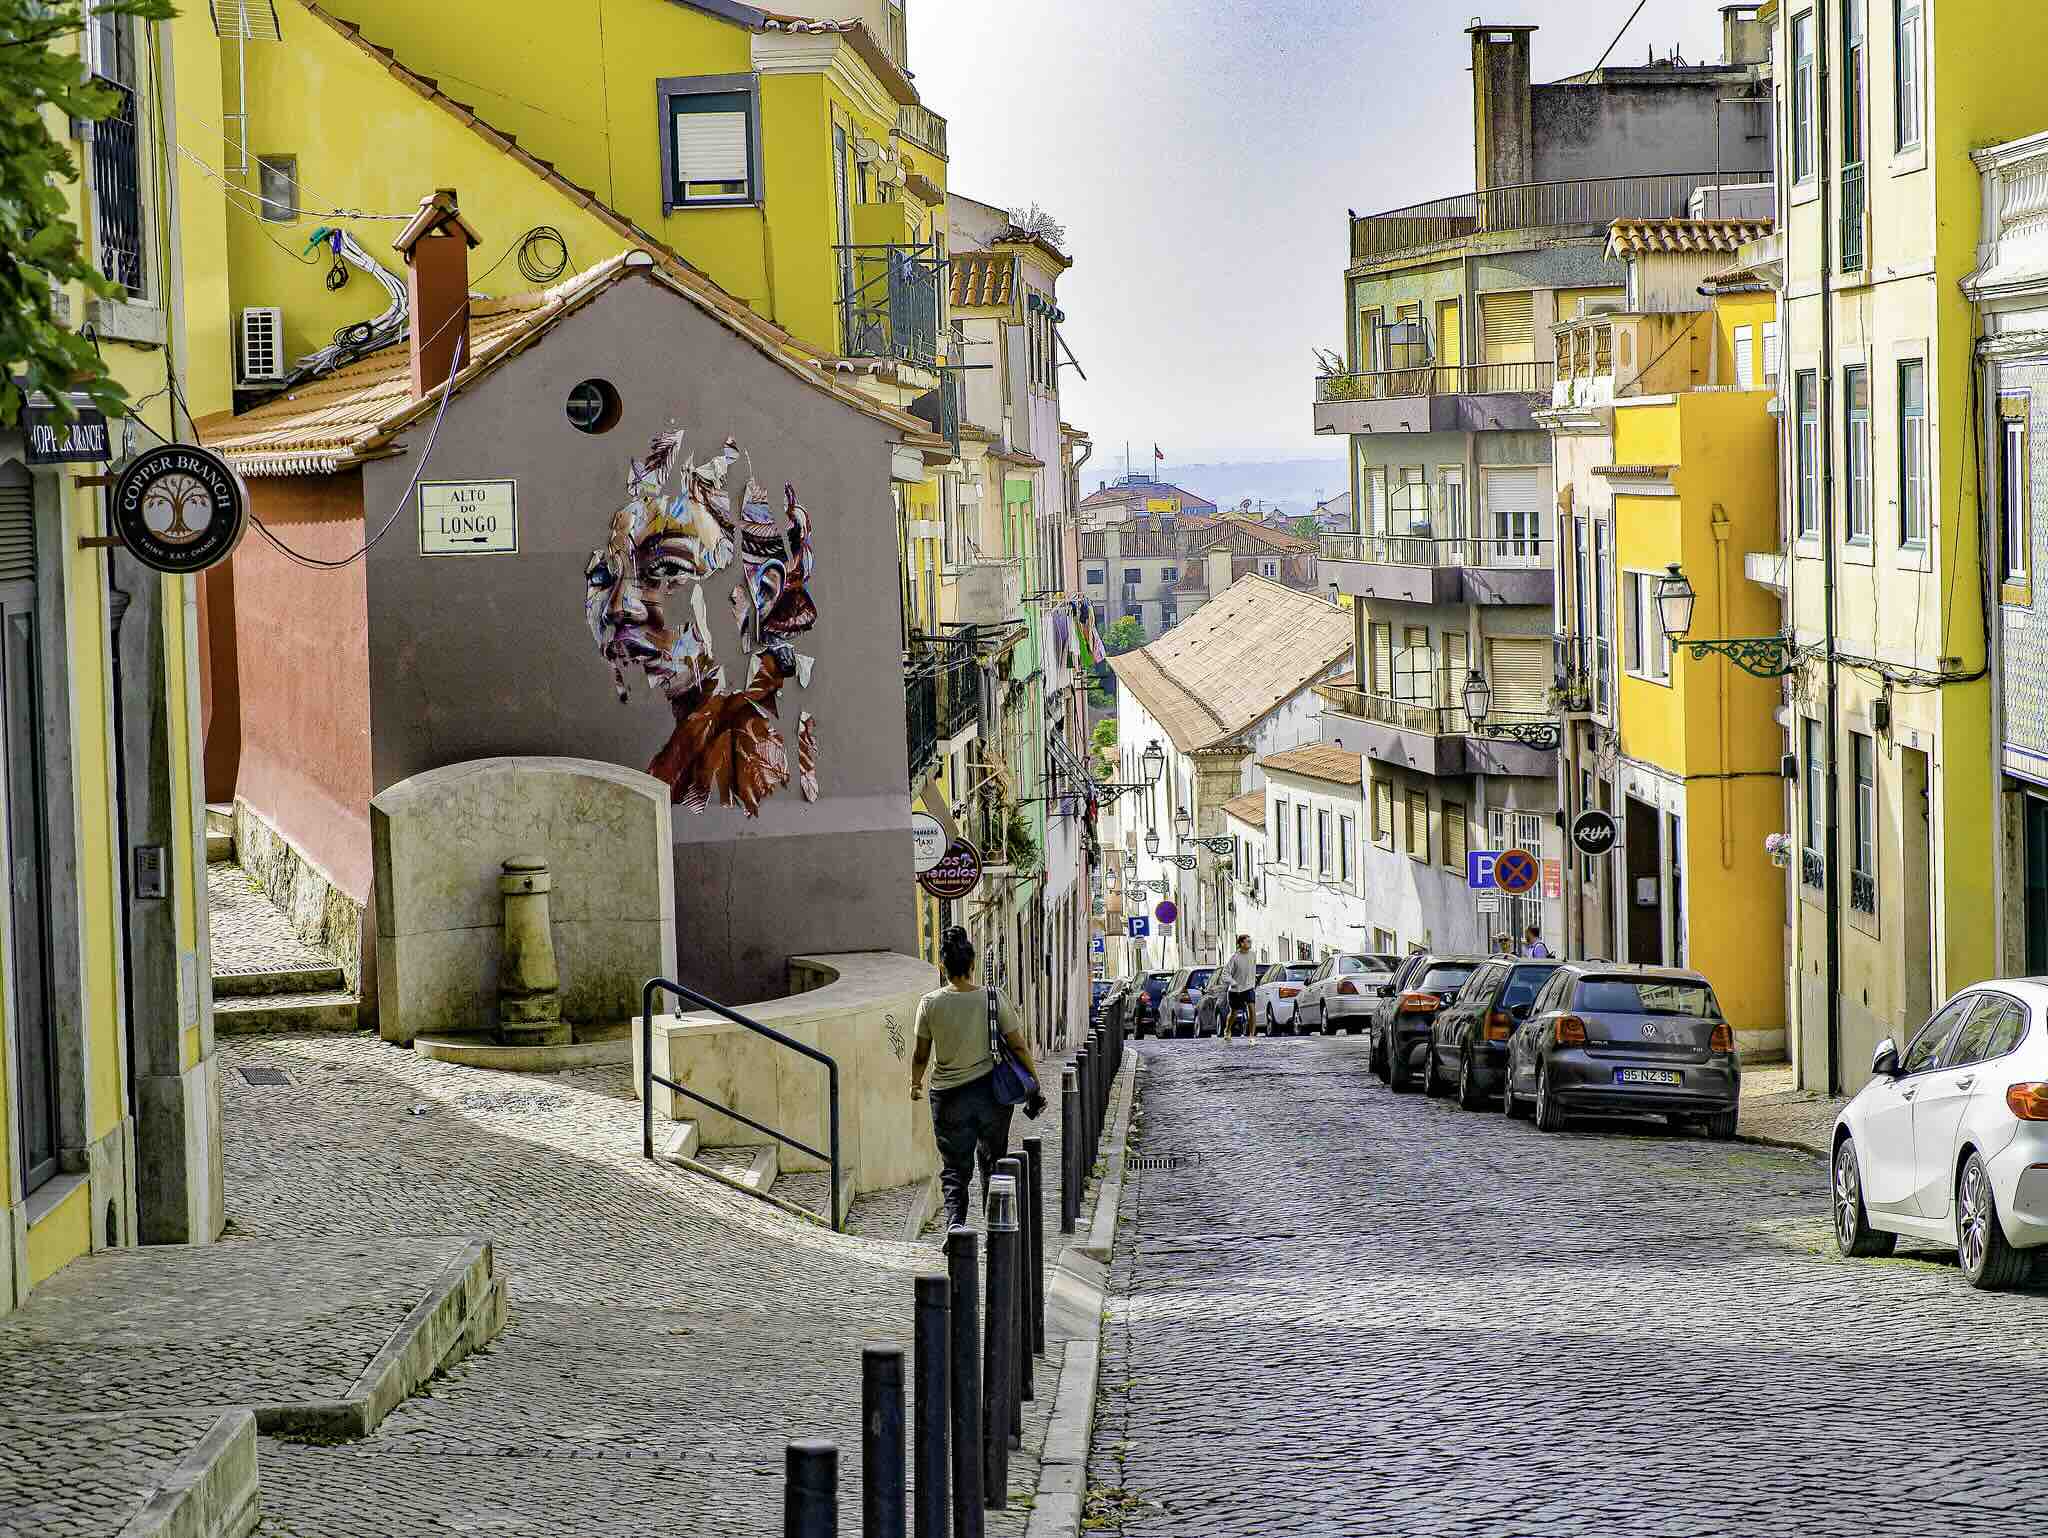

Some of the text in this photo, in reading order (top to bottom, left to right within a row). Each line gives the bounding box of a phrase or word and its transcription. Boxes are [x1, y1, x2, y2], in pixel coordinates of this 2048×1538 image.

[124, 455, 232, 511] COPPER BRANCH
[451, 489, 486, 503] ALTO
[460, 505, 476, 513] DO
[440, 515, 497, 534] LONGO
[1578, 825, 1611, 843] RUA
[941, 856, 960, 866] os
[1477, 855, 1496, 884] P
[1133, 919, 1145, 935] P
